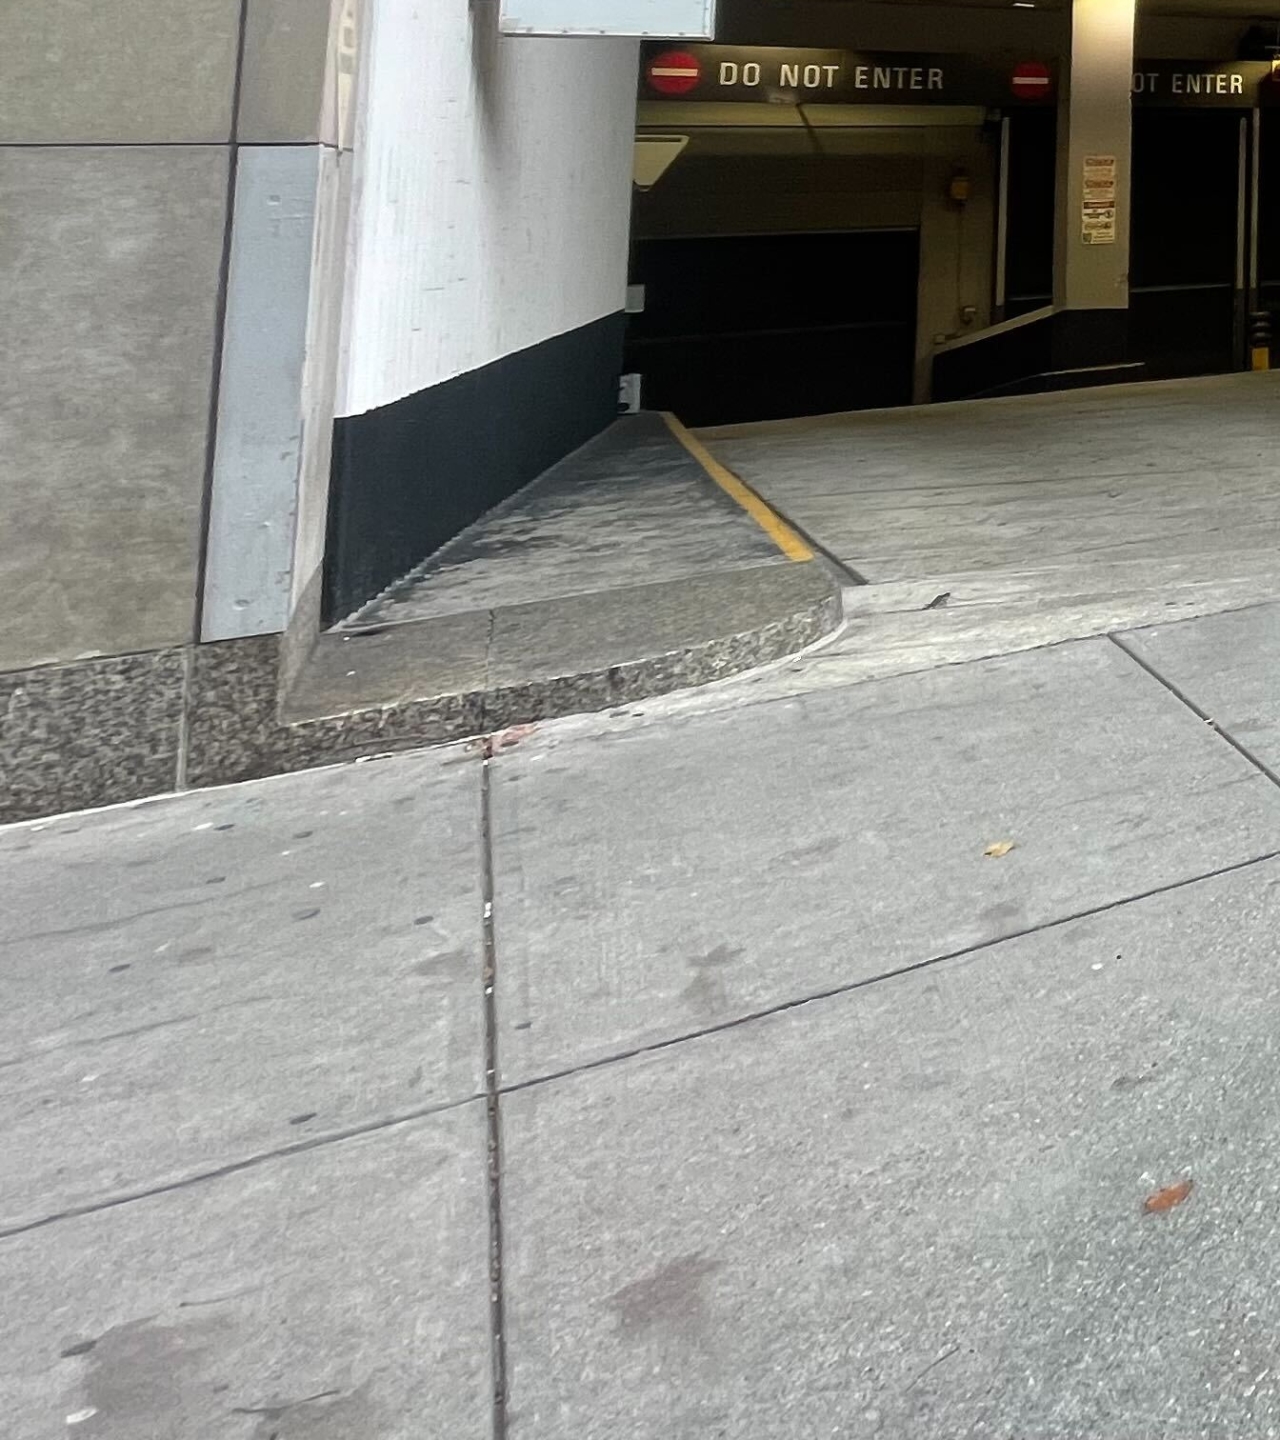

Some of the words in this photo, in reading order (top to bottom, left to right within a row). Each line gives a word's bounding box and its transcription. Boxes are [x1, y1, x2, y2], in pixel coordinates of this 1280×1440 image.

[719, 62, 761, 87] DO
[779, 64, 840, 88] NOT
[854, 66, 944, 90] ENTER
[1132, 72, 1160, 93] OT
[1171, 73, 1243, 94] ENTER
